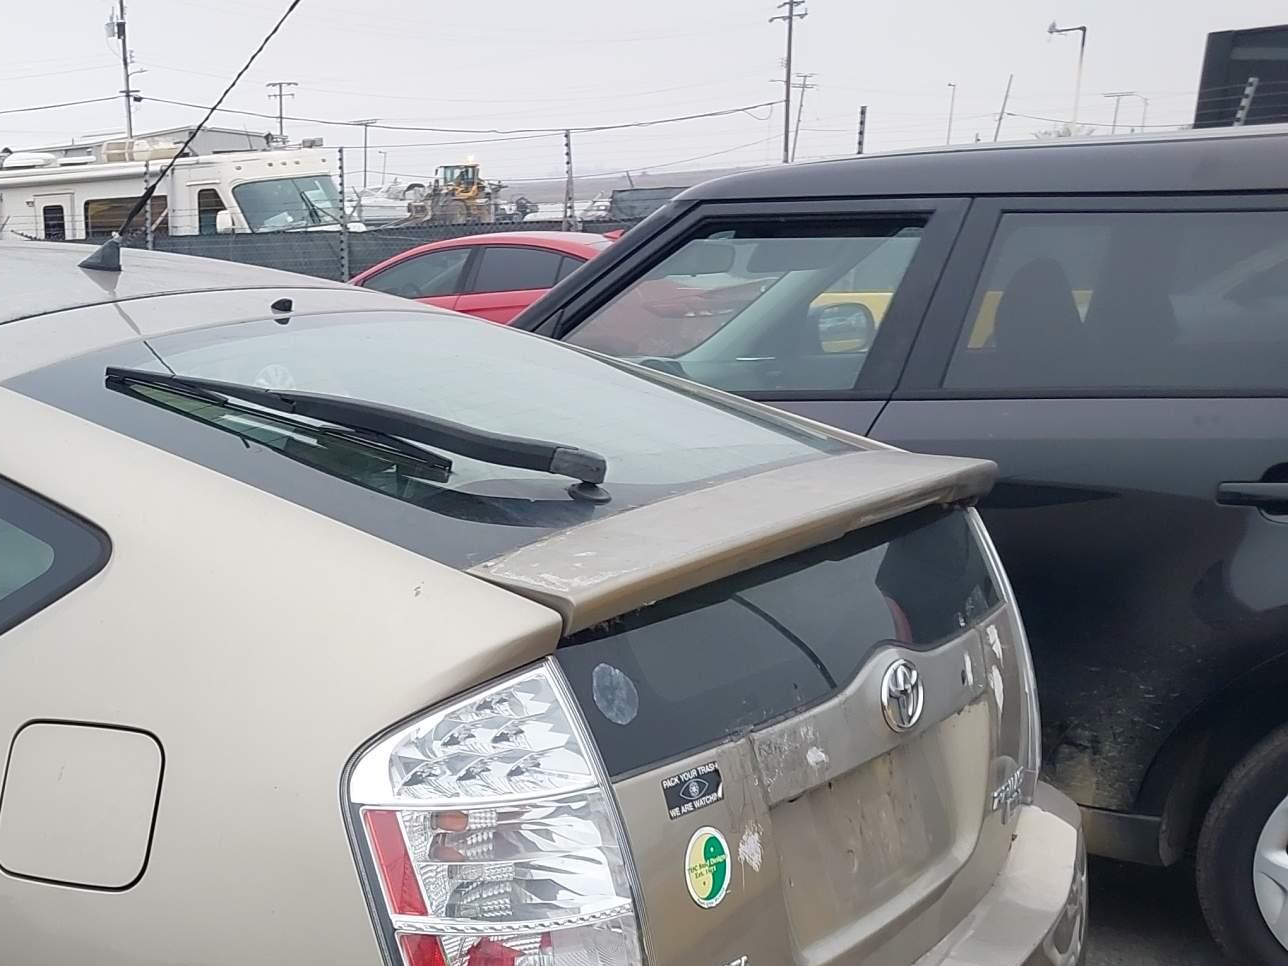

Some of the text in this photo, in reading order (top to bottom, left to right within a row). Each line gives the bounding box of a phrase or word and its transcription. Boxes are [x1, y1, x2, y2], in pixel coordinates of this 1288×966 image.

[662, 776, 680, 789] PACK
[680, 769, 698, 782] YOUR
[669, 807, 681, 817] WE
[681, 802, 694, 814] ARE
